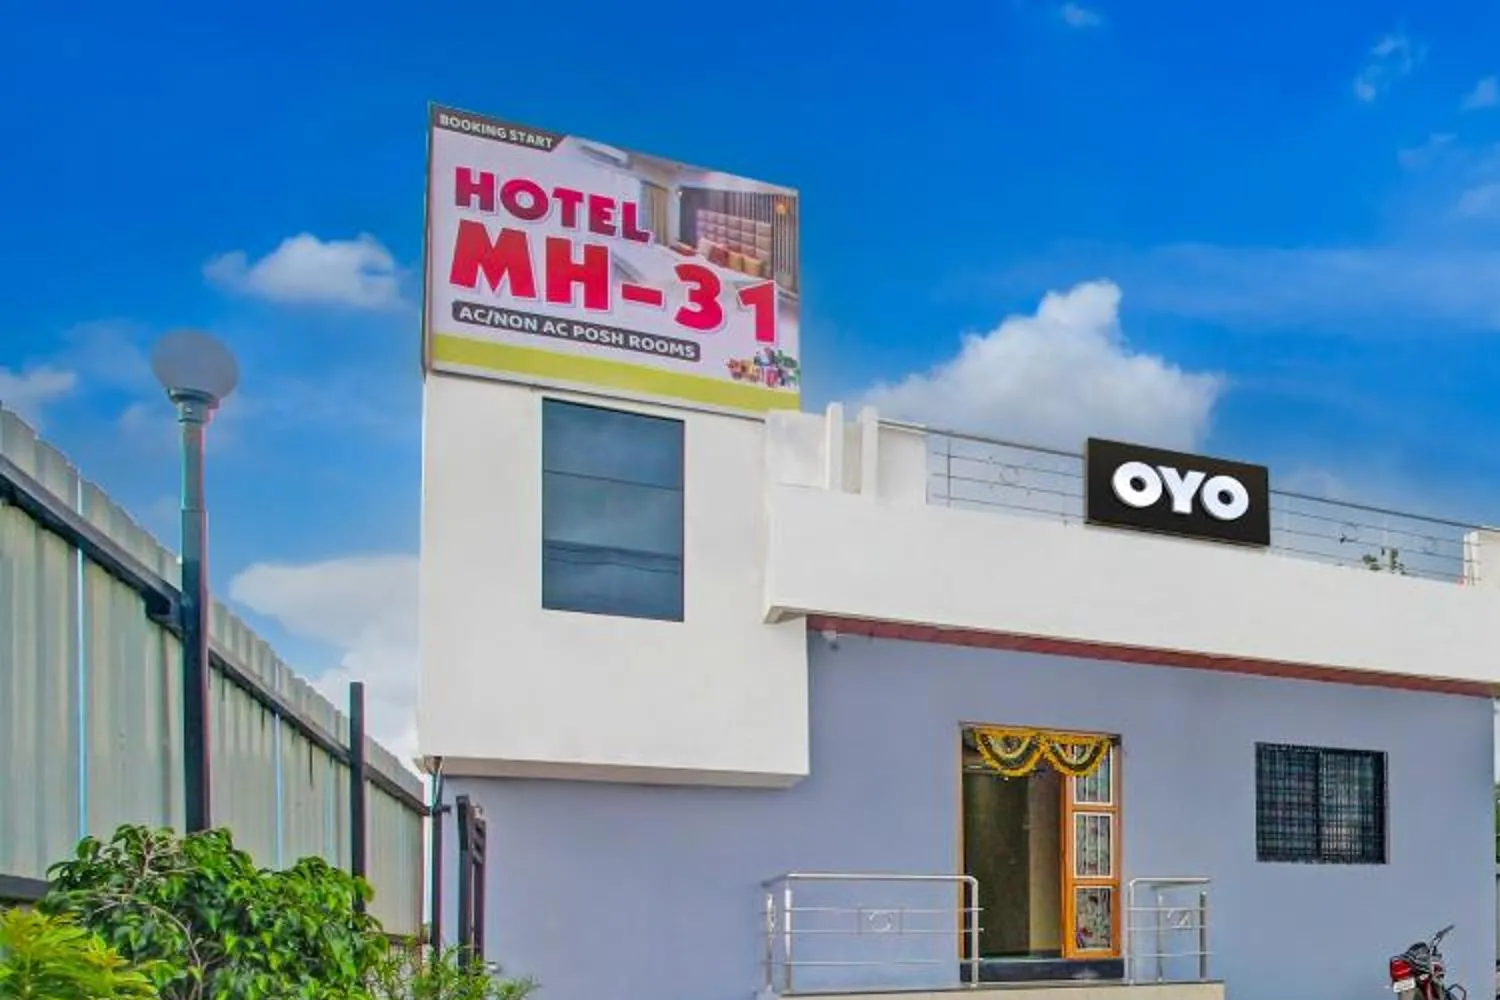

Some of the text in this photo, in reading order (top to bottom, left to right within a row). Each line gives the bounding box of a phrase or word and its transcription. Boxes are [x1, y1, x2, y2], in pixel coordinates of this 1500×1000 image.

[439, 113, 553, 149] BOOKING START
[455, 167, 651, 243] HOTEL
[449, 219, 776, 343] MH-31
[459, 306, 697, 359] AC/NON AC POSH ROOMS
[1112, 461, 1249, 520] OYO
